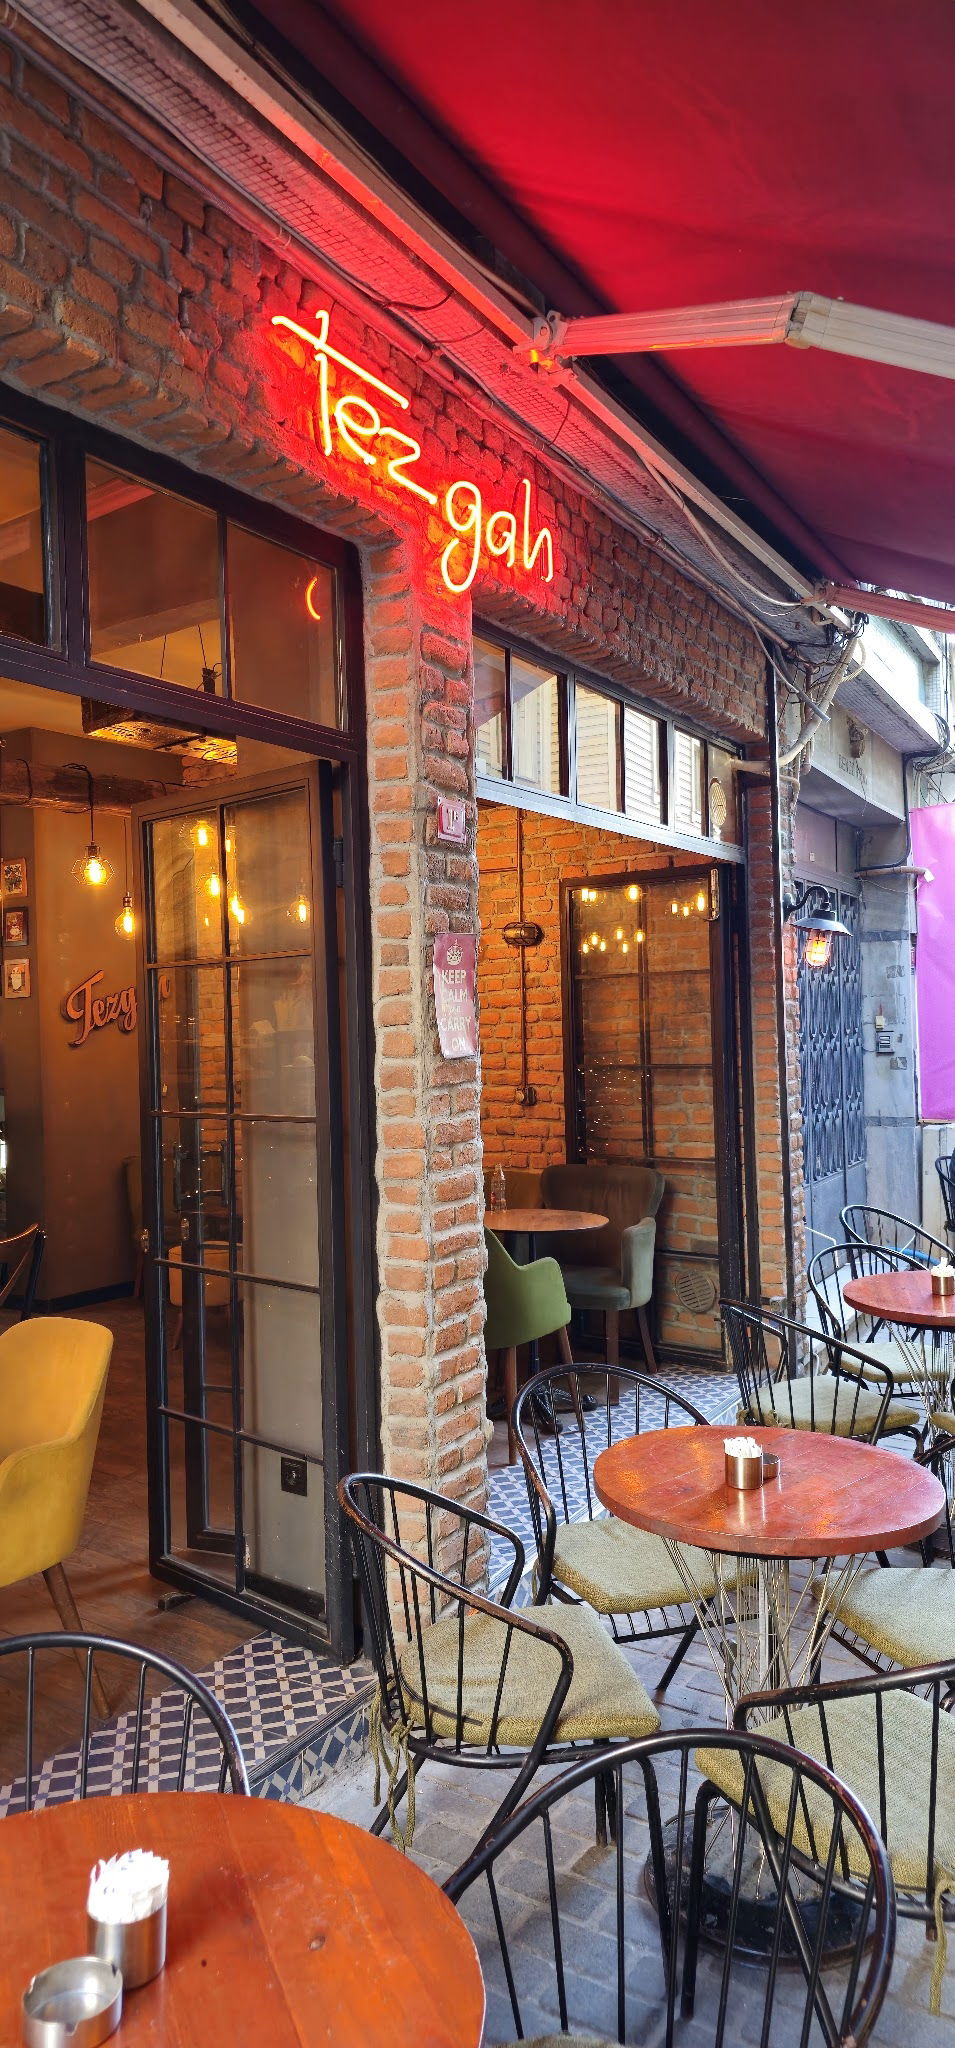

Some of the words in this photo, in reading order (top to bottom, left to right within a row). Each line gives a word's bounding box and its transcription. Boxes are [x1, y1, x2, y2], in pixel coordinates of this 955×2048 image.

[441, 969, 467, 985] KEEP
[440, 1016, 471, 1032] CARRY
[451, 1037, 466, 1051] ON
